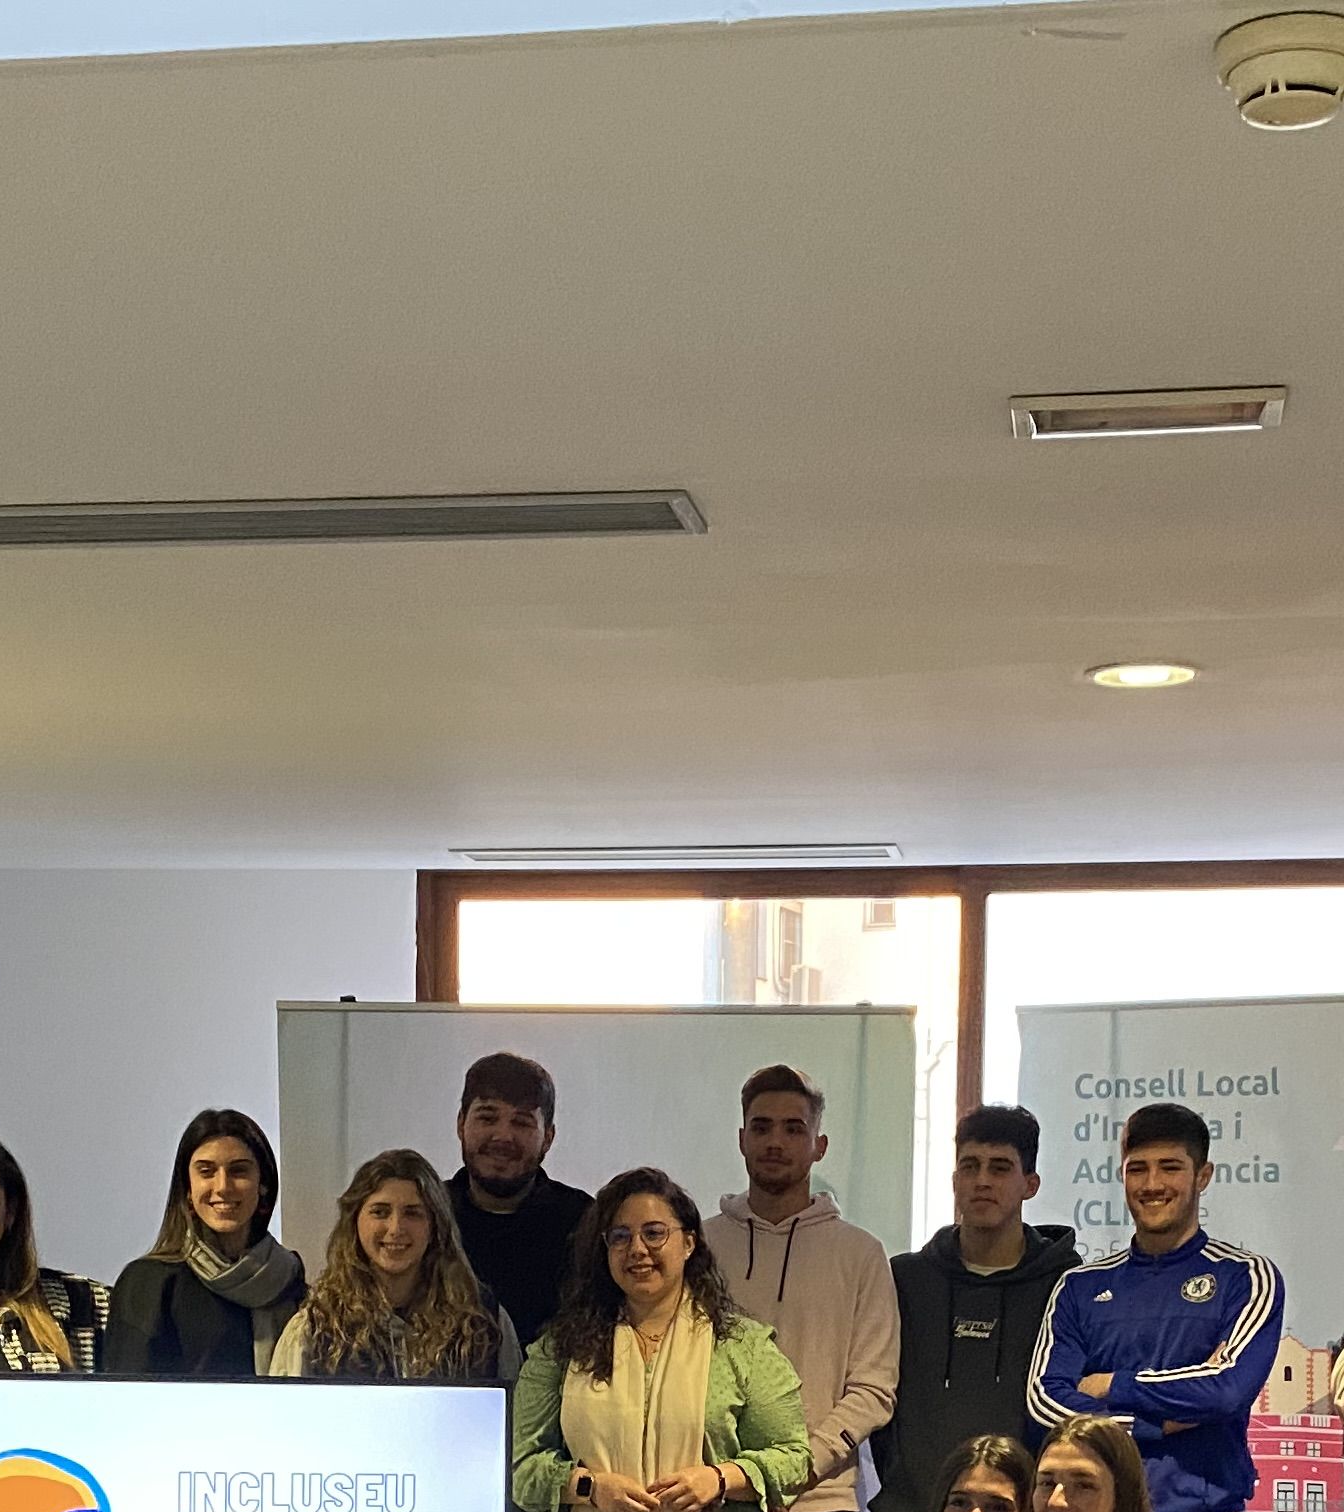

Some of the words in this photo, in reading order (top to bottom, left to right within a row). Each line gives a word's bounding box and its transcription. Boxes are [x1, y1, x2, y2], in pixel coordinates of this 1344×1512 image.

[1075, 1068, 1186, 1099] Consell
[1197, 1066, 1280, 1097] Local
[1235, 1111, 1242, 1139] i
